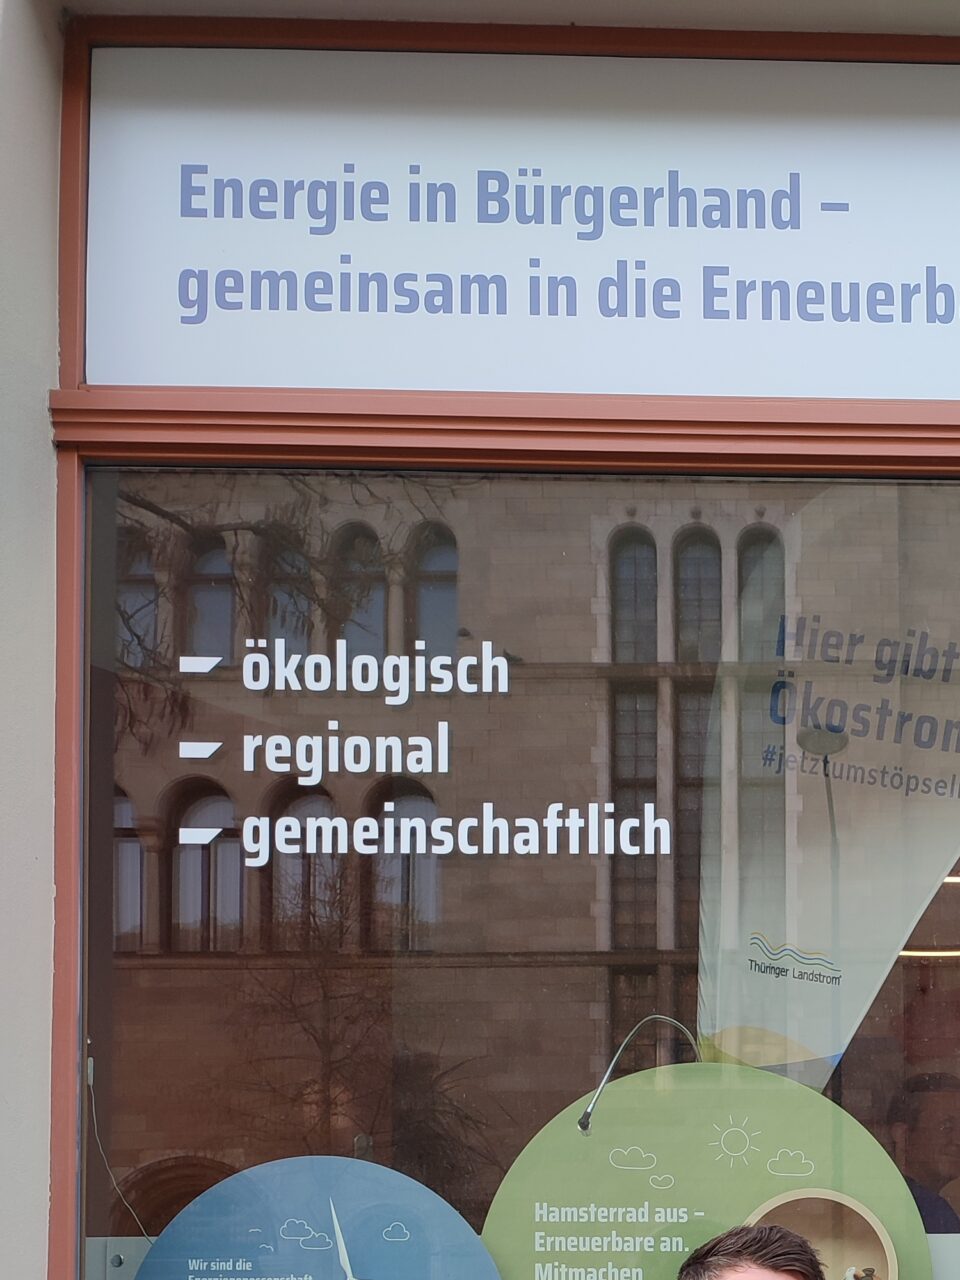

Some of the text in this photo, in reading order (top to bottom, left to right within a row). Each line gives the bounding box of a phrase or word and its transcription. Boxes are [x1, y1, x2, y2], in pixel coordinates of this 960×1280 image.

[179, 163, 390, 236] Energie
[408, 164, 457, 224] in
[476, 168, 801, 241] Bürgerhand
[178, 254, 508, 325] gemeinsam
[528, 258, 579, 317] in
[598, 260, 682, 319] die
[775, 614, 865, 666] Hier
[242, 637, 510, 706] ökologisch
[242, 719, 450, 786] regional
[242, 801, 672, 868] gemeinschaftlich
[748, 958, 841, 986] Thüringer Landstrom
[534, 1201, 650, 1223] Hamsterrad
[654, 1207, 689, 1223] aus
[534, 1230, 690, 1252] Erneuerbare an.
[188, 1259, 252, 1271] Wir sind die
